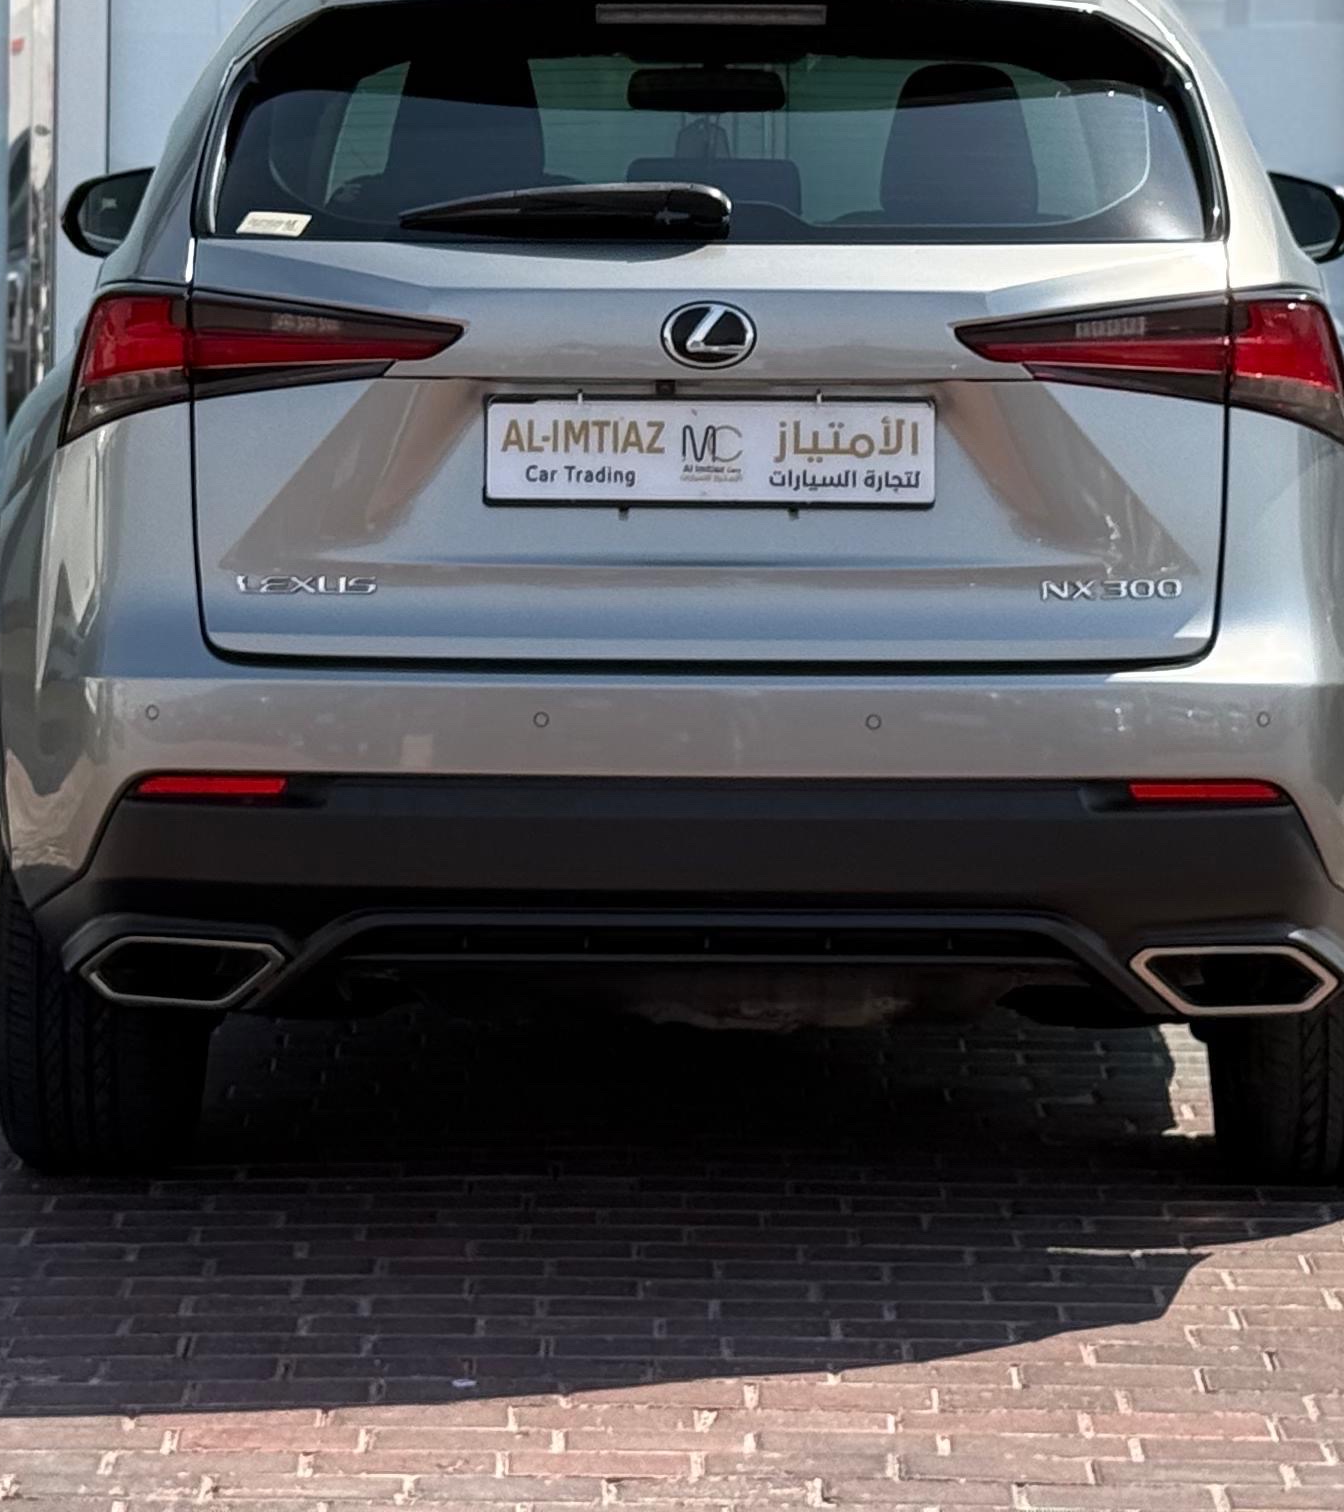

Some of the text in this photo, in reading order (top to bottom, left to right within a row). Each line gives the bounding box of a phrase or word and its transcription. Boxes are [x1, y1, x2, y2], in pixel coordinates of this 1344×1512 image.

[501, 419, 665, 454] AL-IMTIAZ
[525, 464, 636, 487] Car Trading
[768, 469, 856, 491] السيارات
[863, 470, 921, 492] لتجارة
[236, 575, 377, 595] LEXUS
[1040, 579, 1183, 600] NX 300
